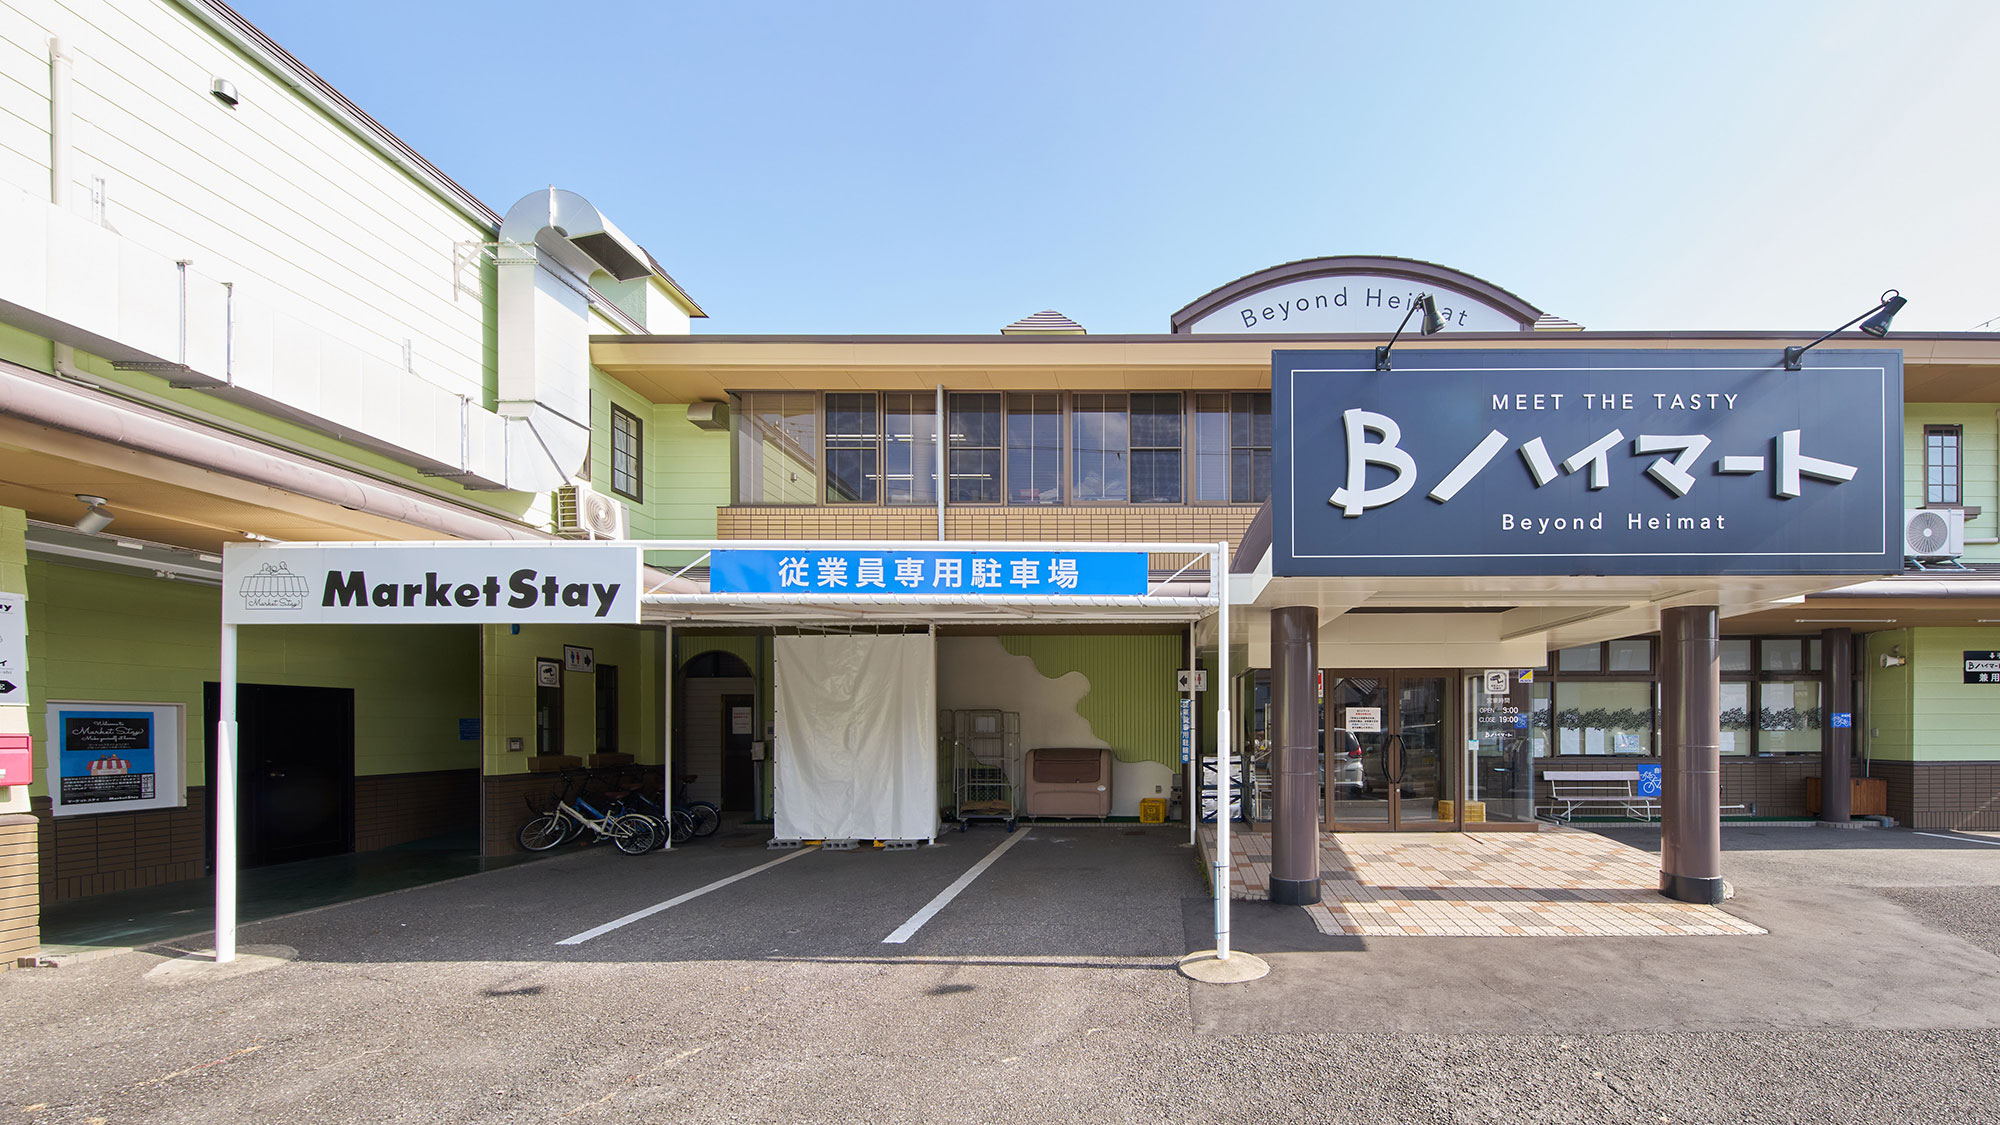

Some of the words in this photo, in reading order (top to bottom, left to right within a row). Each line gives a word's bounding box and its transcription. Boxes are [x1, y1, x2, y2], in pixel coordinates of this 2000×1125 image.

[1241, 286, 1348, 329] Beyond
[1366, 288, 1468, 327] Heiat
[1493, 394, 1564, 411] MEET
[1584, 394, 1634, 411] THE
[1657, 393, 1739, 411] TASTY
[1502, 513, 1603, 534] Beyond
[1628, 513, 1726, 530] Heimat
[778, 557, 1079, 589] 従業員専用駐車場
[72, 727, 115, 735] Market
